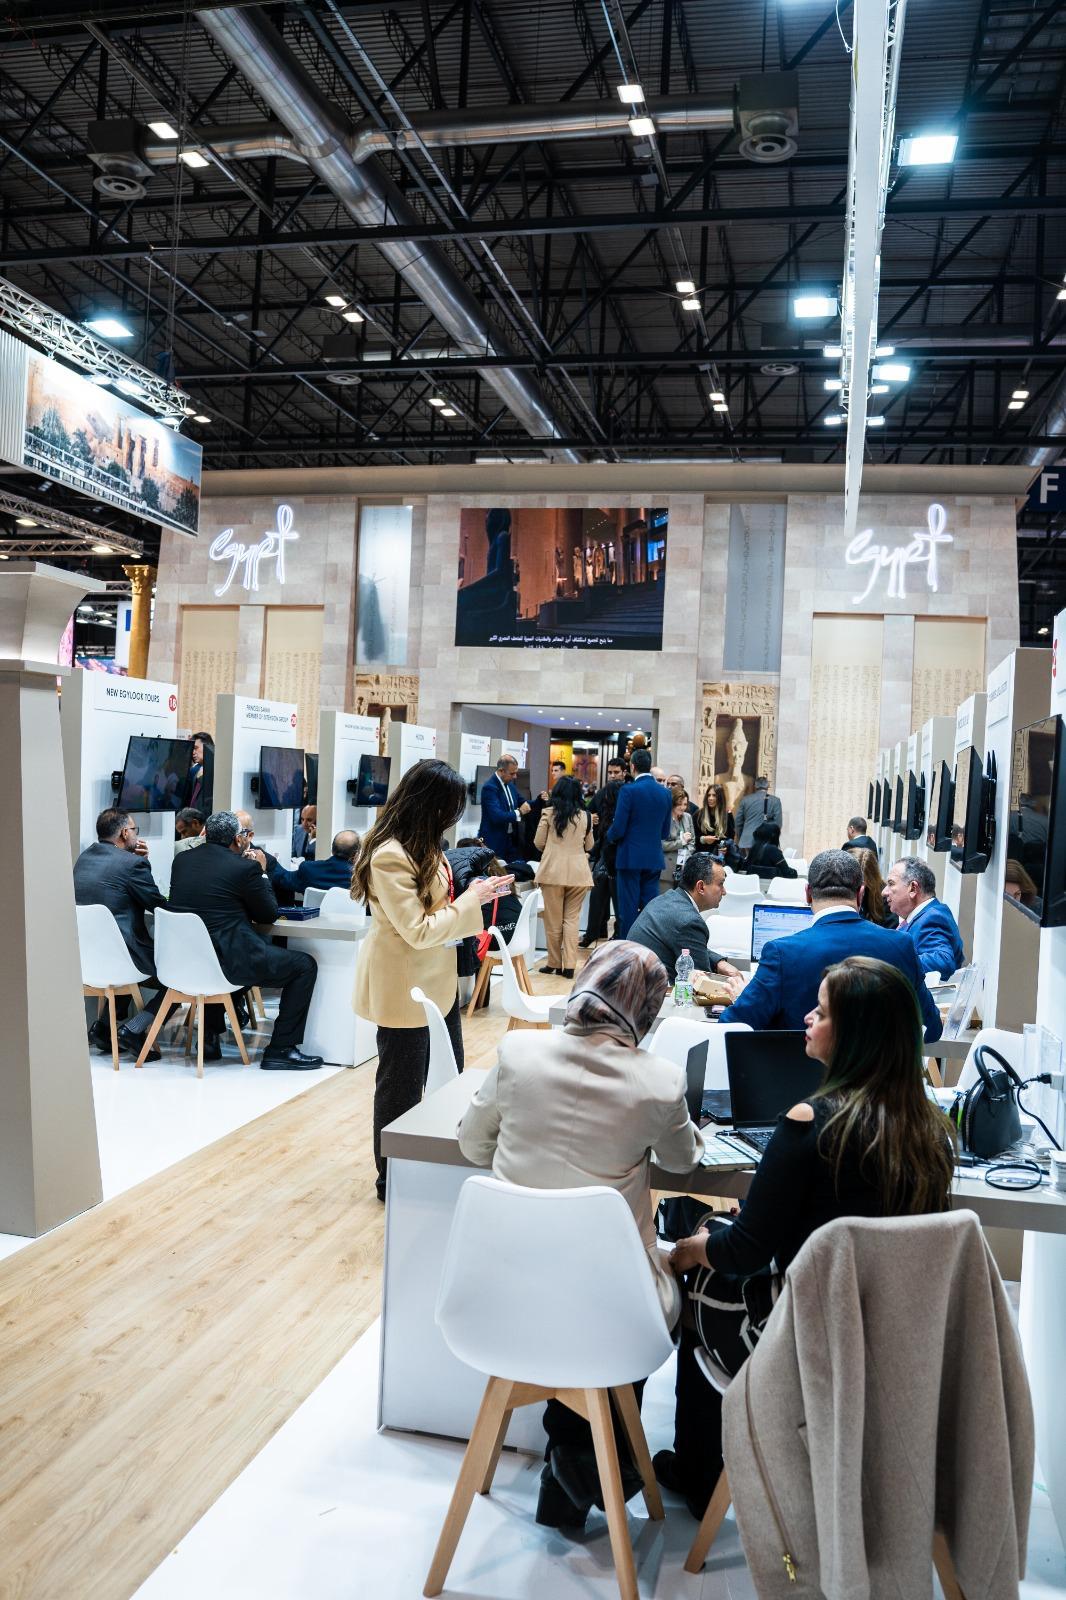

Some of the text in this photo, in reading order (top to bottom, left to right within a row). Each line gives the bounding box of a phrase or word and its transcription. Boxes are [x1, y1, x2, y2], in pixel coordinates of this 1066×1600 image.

[1039, 482, 1060, 514] F
[106, 687, 160, 703] NEW EGYLOOK TOURS
